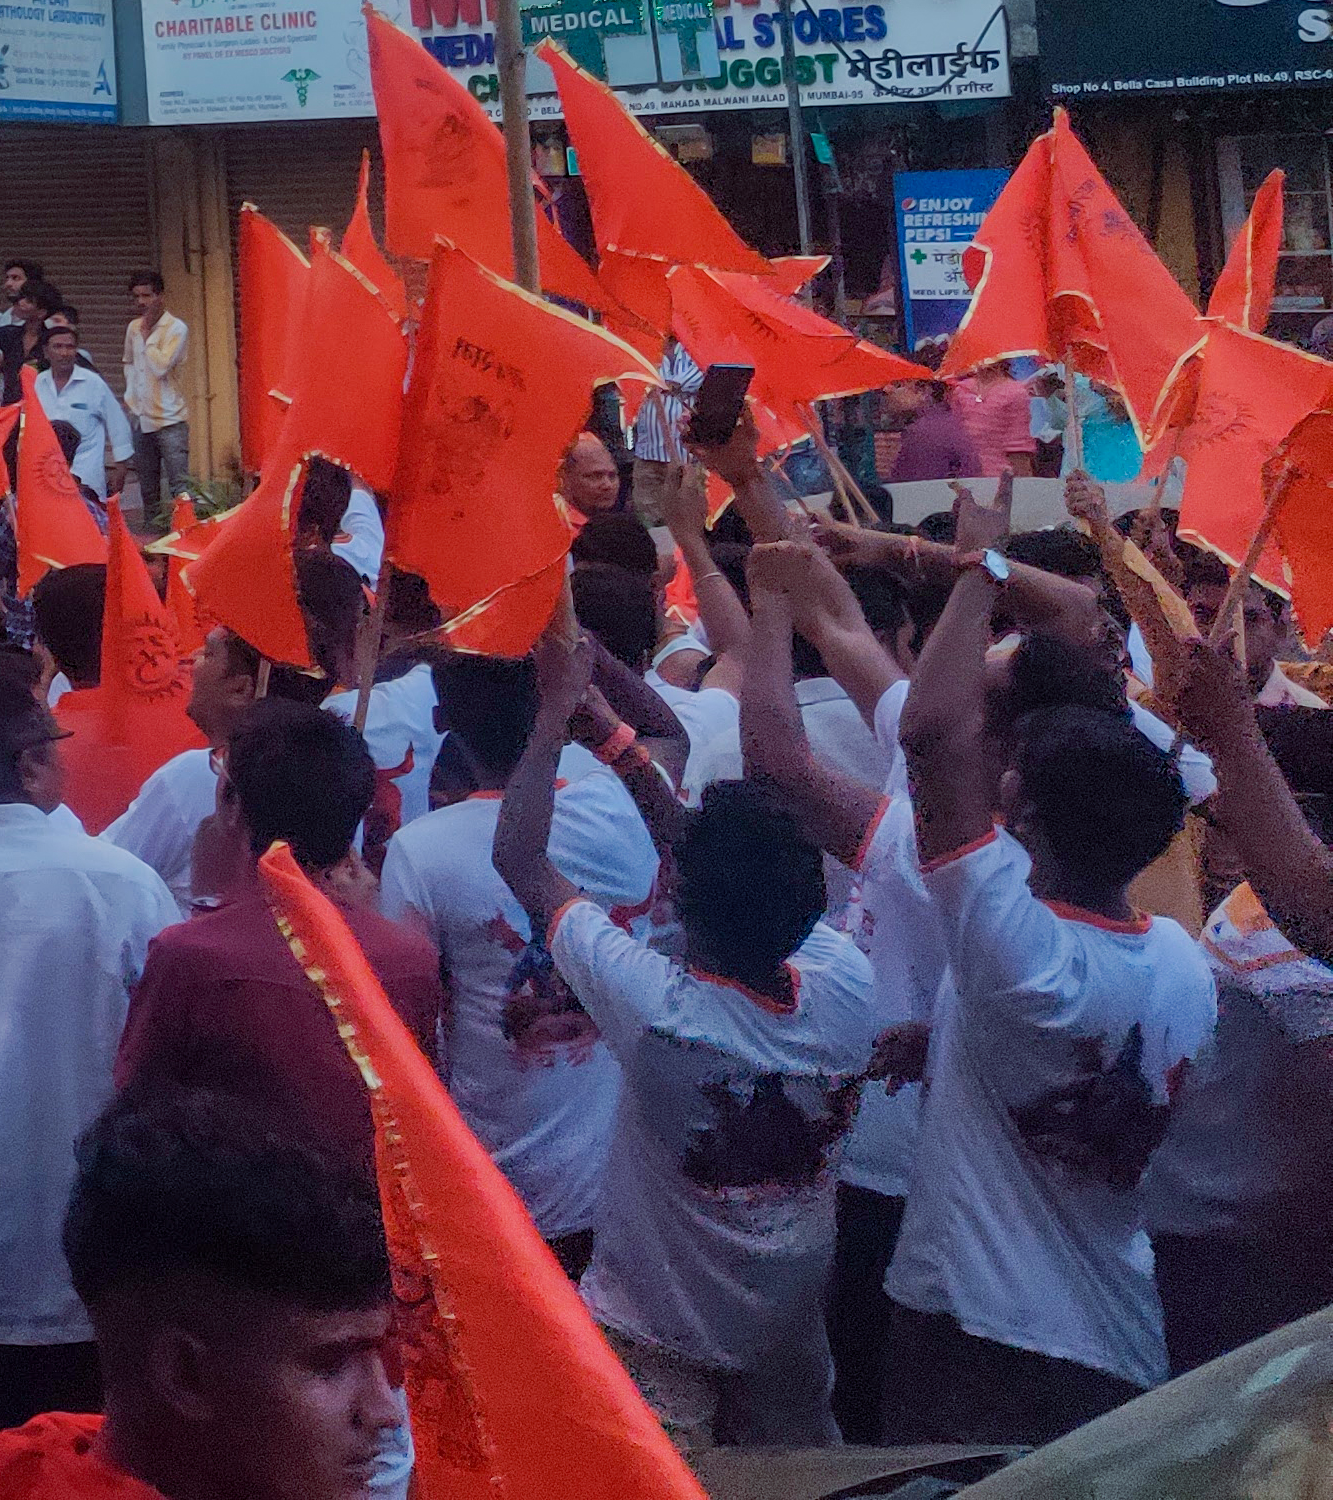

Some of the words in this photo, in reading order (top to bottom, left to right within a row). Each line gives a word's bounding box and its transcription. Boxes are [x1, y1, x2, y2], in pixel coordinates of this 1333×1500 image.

[48, 10, 106, 28] LABORATORY
[531, 6, 633, 34] MEDICAL
[663, 2, 708, 21] MEDICAL
[154, 15, 255, 39] CHARITABLE
[260, 10, 318, 31] CLINIC
[1051, 83, 1081, 95] Shop
[1083, 82, 1099, 93] No
[1100, 81, 1112, 93] 4,
[1113, 79, 1143, 91] Bella
[1145, 78, 1174, 90] Casa
[1176, 76, 1225, 89] Building
[1227, 74, 1252, 85] Plot
[1254, 71, 1292, 84] No.49,
[660, 99, 701, 110] MAHADA
[703, 96, 749, 107] MALWANI
[751, 93, 786, 104] MALAD
[806, 90, 864, 101] MUMBAI-95
[919, 197, 974, 212] ENJOY
[905, 228, 951, 242] PEPSI
